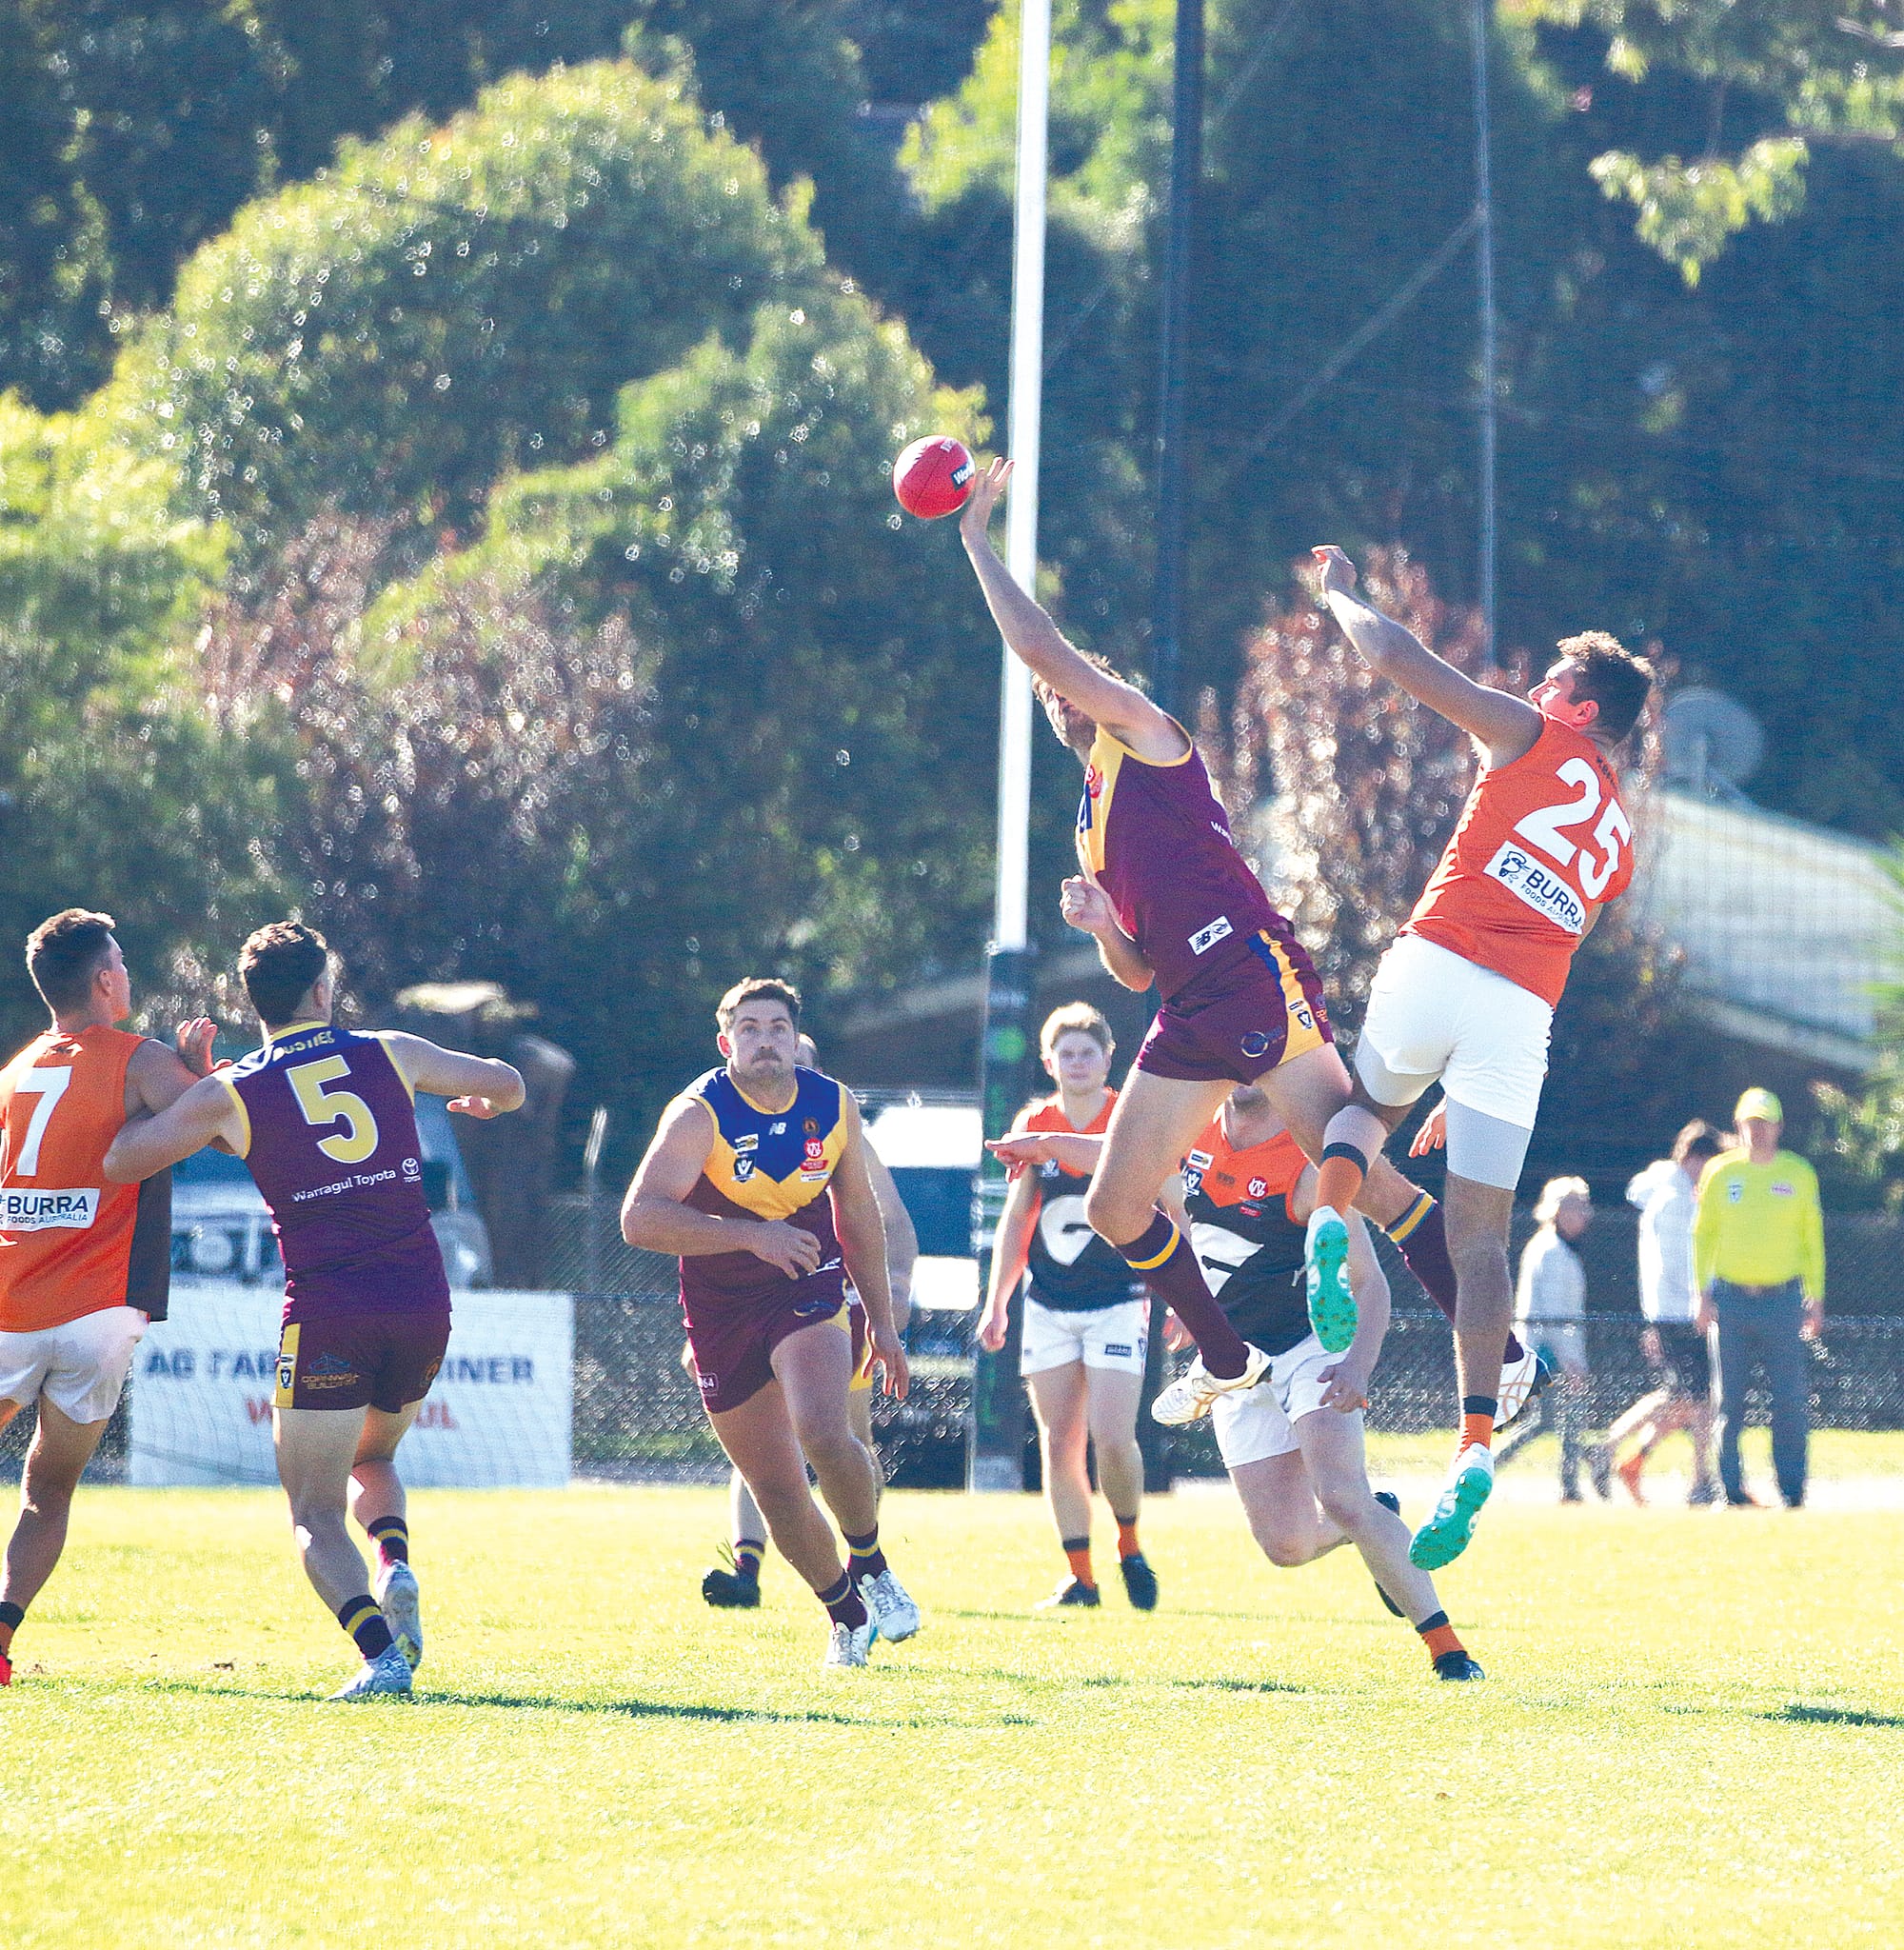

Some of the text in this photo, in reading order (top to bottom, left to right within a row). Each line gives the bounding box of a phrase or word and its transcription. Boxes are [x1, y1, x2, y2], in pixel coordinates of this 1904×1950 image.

[1512, 757, 1632, 901] 25
[1520, 884, 1548, 907] FOODS
[14, 1065, 73, 1177] 7
[285, 1054, 379, 1164] 5
[291, 1169, 397, 1203] Warragul Toyota
[8, 1195, 89, 1216] BURRA
[8, 1215, 37, 1224] FOODS
